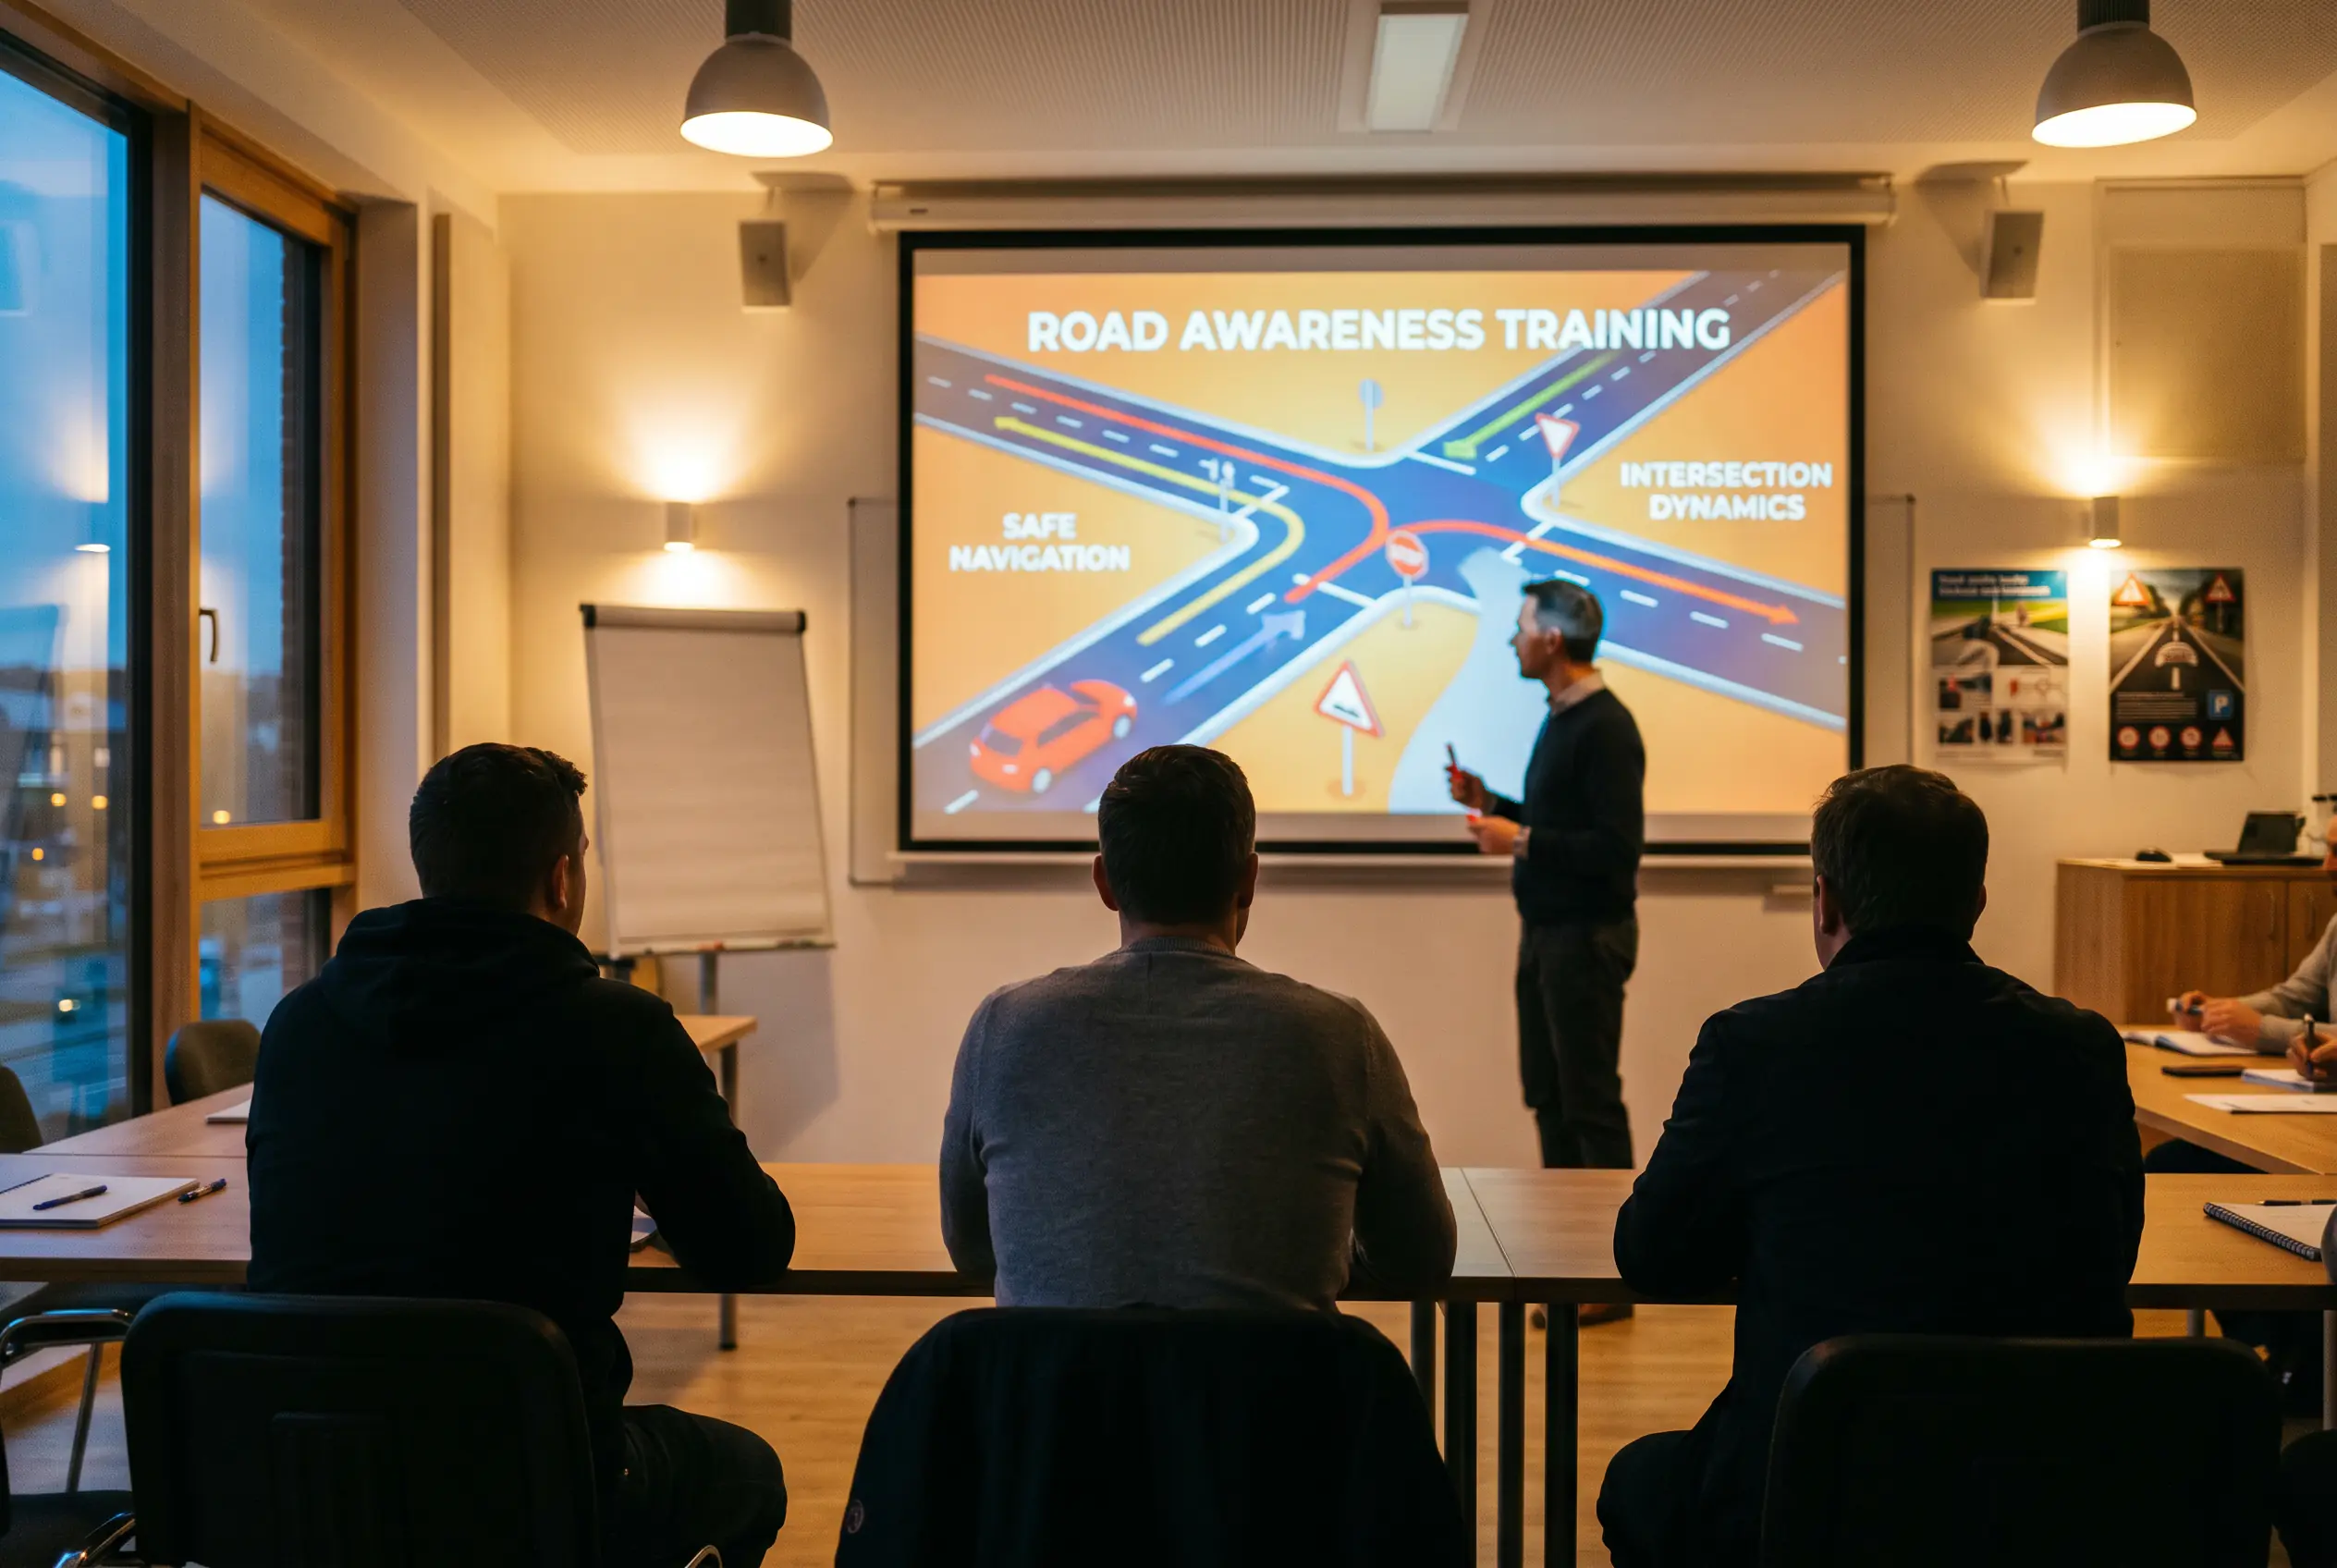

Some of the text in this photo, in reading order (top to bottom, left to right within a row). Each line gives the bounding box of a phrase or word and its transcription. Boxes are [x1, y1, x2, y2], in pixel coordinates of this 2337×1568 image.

[1028, 307, 1731, 352] ROAD AWARENESS TRAINING
[1620, 461, 1833, 488] INTERSECTION
[1648, 494, 1805, 521] DYNAMICS
[1002, 512, 1077, 539] SAFE
[948, 545, 1131, 571] NAVIGATION
[2214, 695, 2229, 714] P
